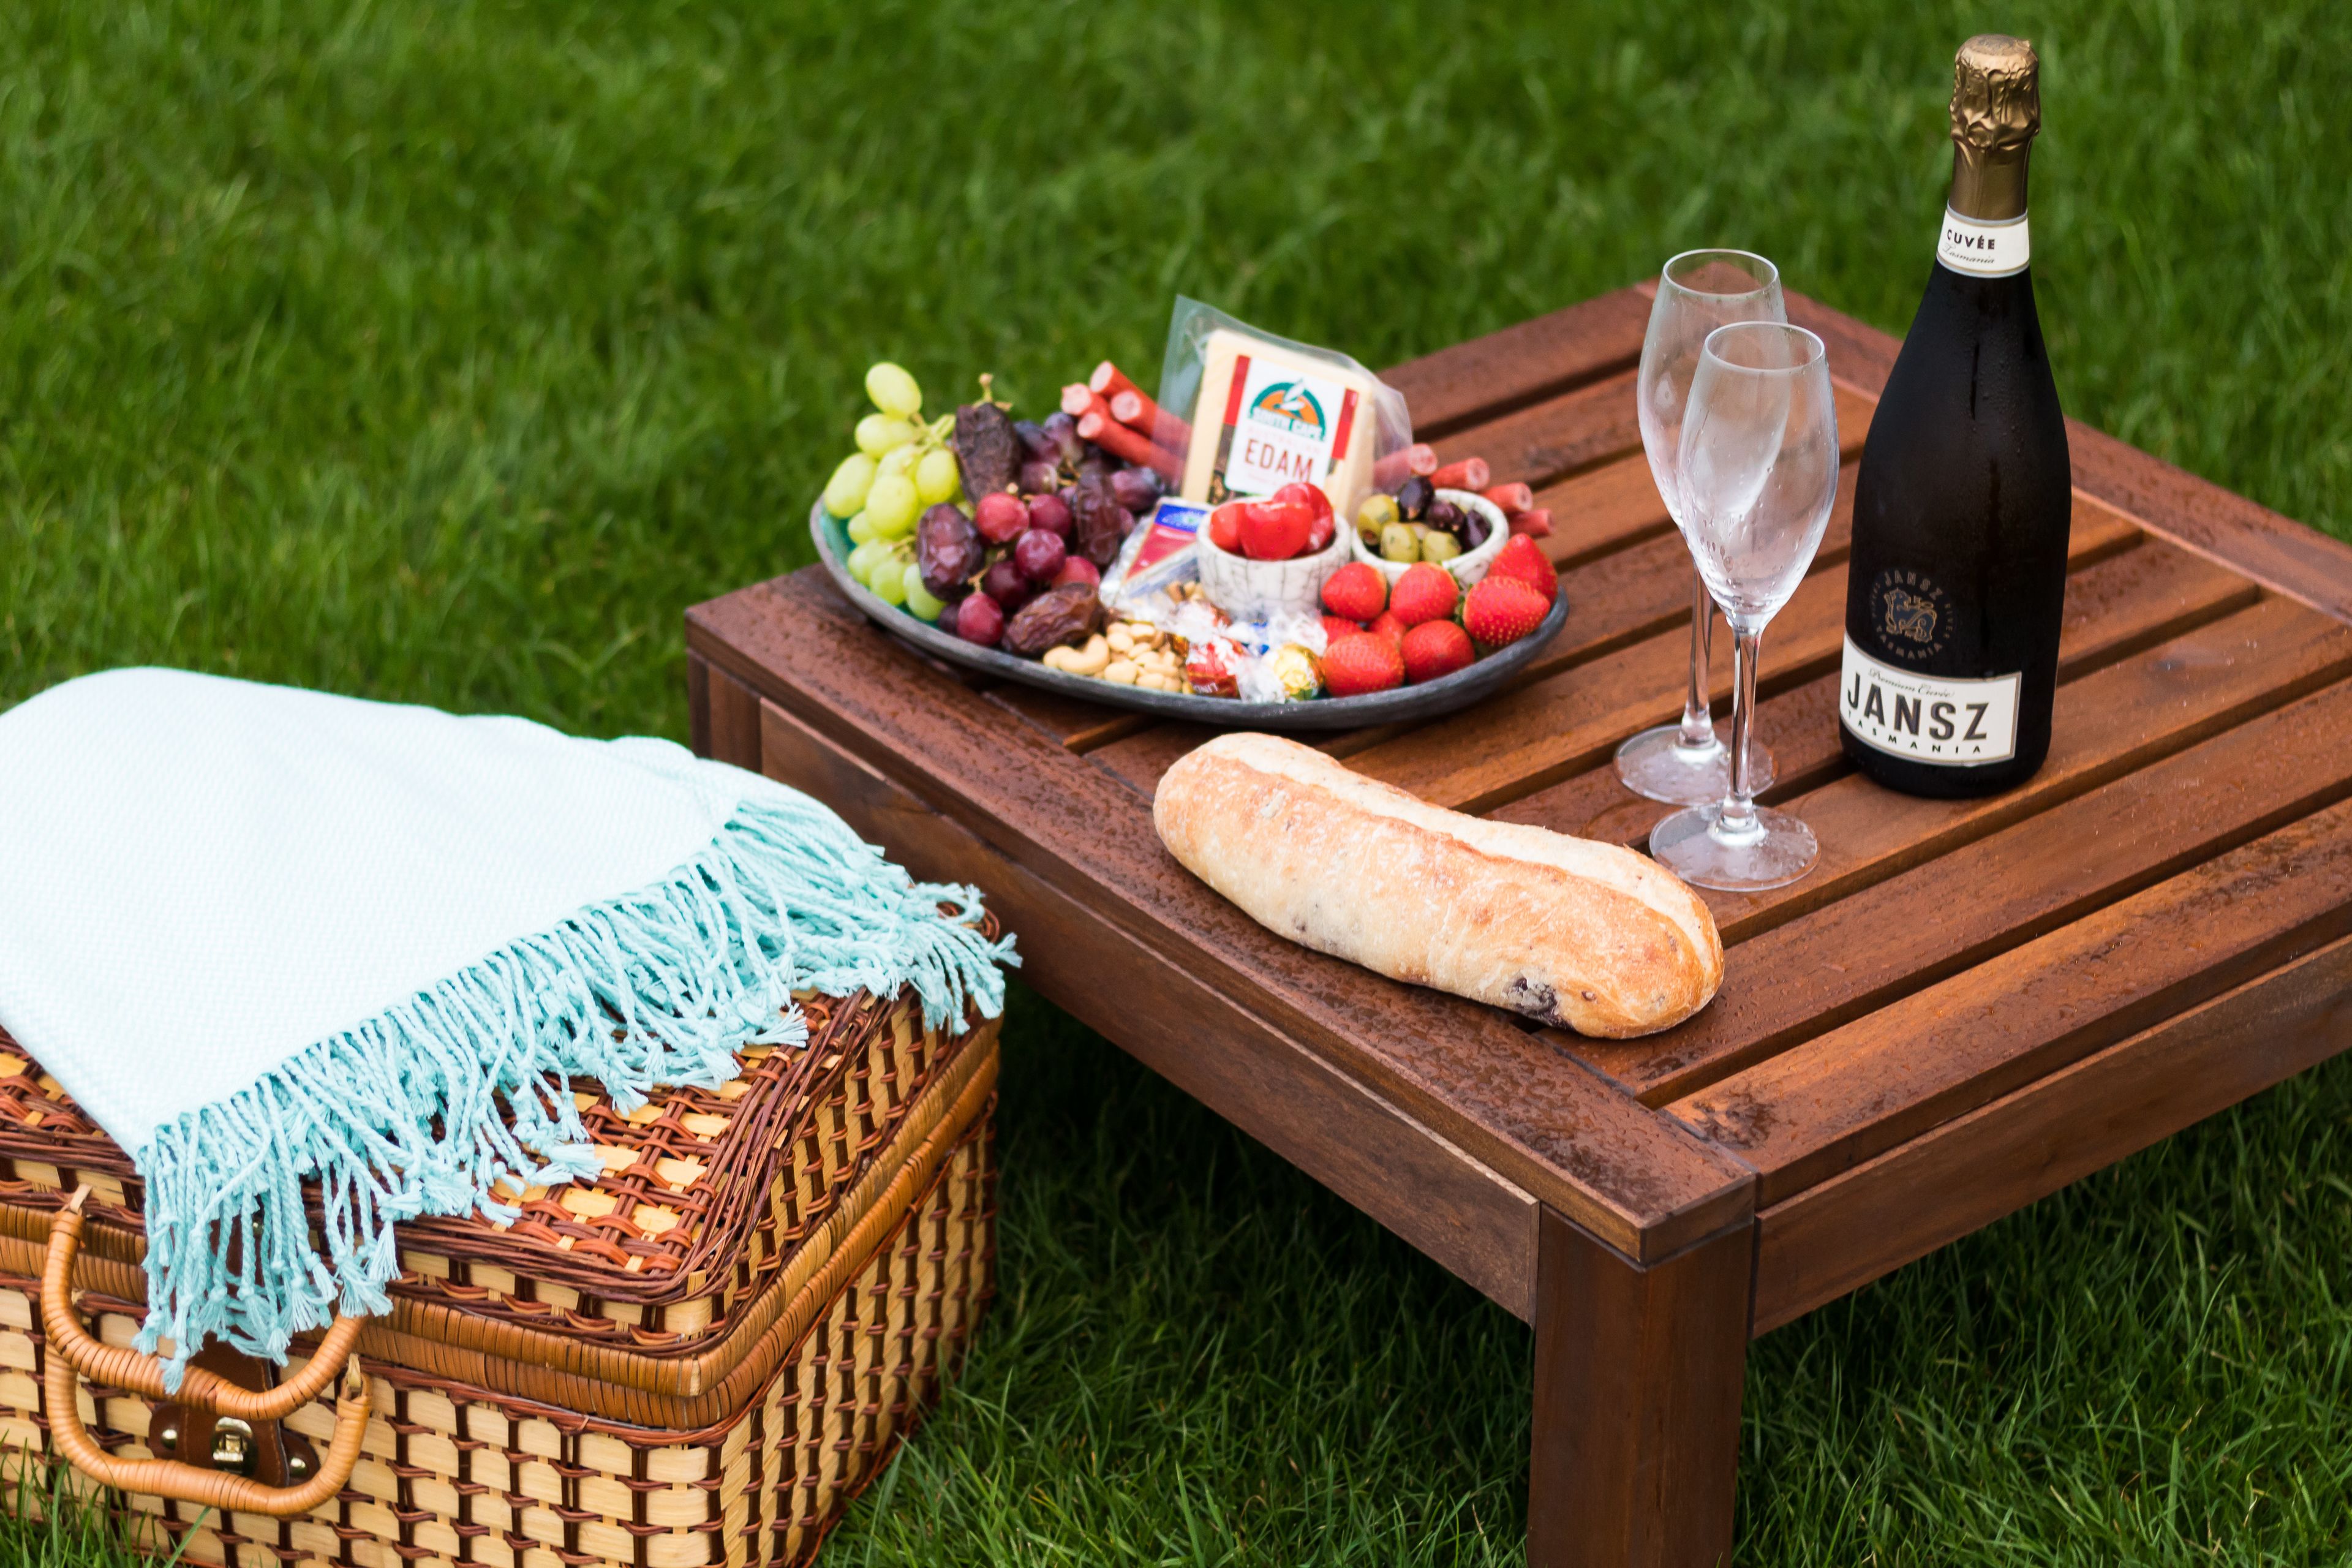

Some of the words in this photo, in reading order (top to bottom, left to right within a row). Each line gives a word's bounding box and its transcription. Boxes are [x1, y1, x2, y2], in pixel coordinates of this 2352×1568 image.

[1942, 244, 1995, 264] Tasmania
[1947, 229, 1995, 250] CUVÉE
[1245, 438, 1313, 483] EDAM
[1884, 569, 1943, 600] JANSZ
[1868, 668, 1915, 692] Premium
[1847, 672, 1989, 741] JANSZ
[1847, 710, 1981, 754] TASMANIA
